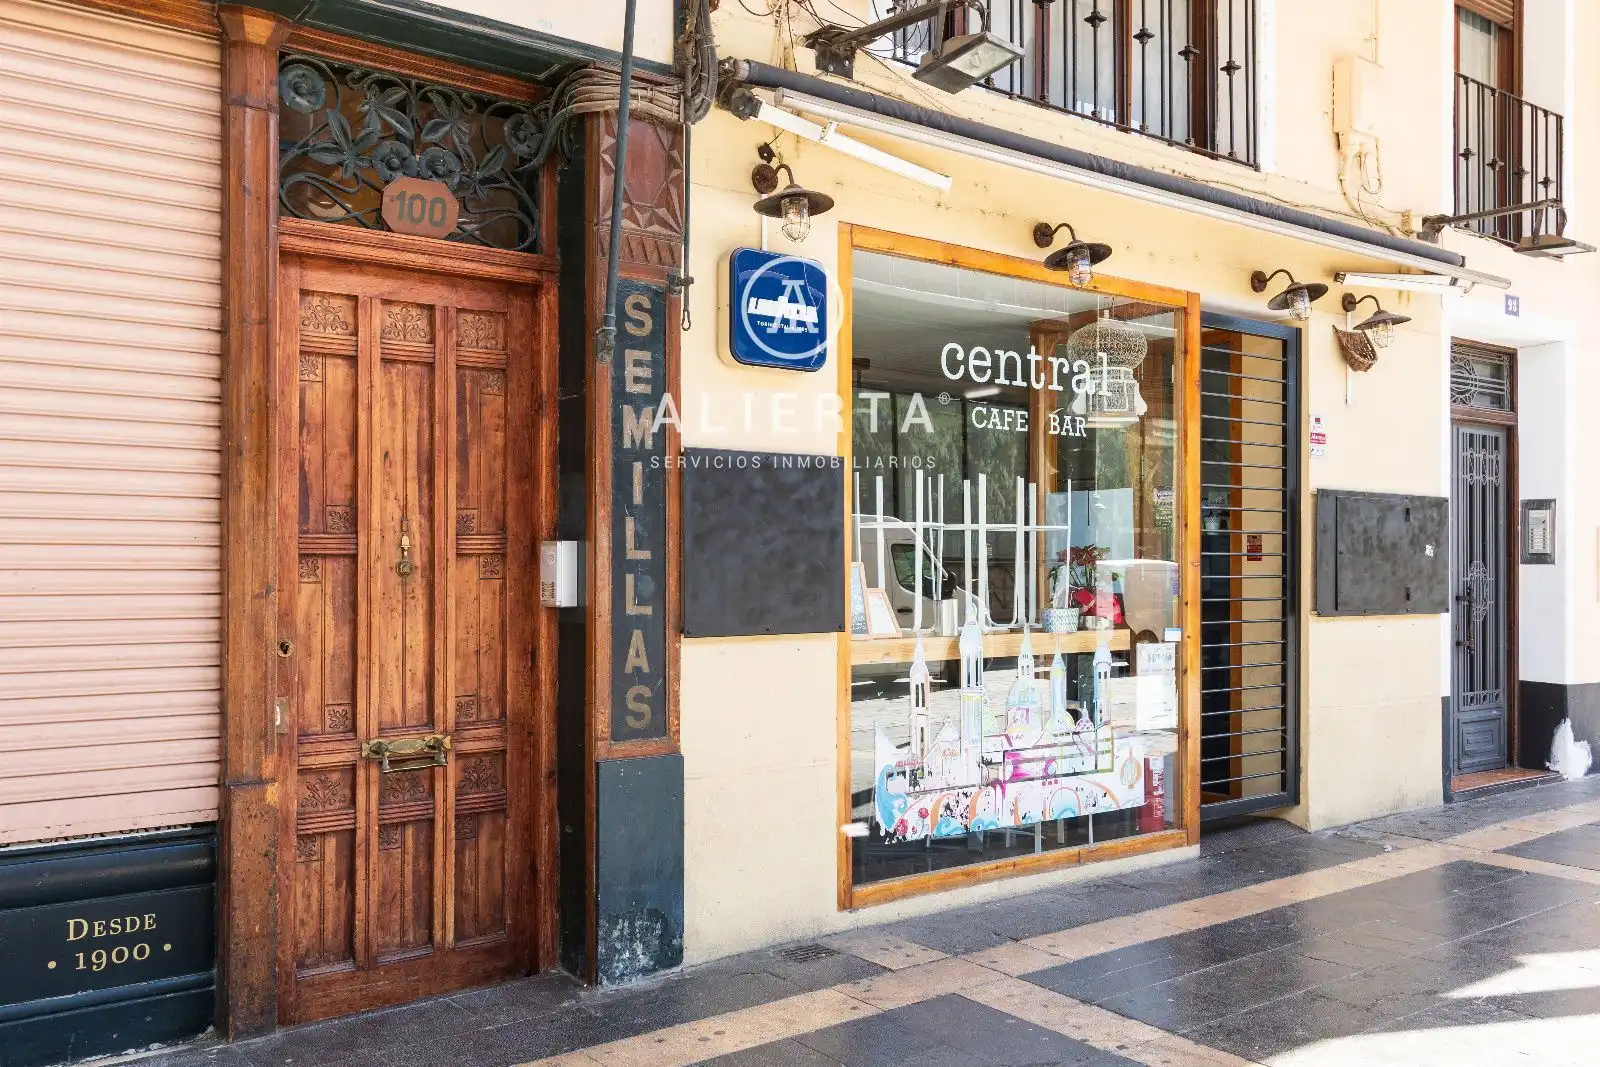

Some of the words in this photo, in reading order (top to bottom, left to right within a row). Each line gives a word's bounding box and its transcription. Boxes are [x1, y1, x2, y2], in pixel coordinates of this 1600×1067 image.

[396, 190, 447, 228] 100
[940, 342, 1112, 397] central
[971, 406, 1029, 432] CAFE
[1048, 413, 1087, 438] BAR
[622, 294, 654, 729] SEMILLAS
[75, 943, 150, 971] 1900
